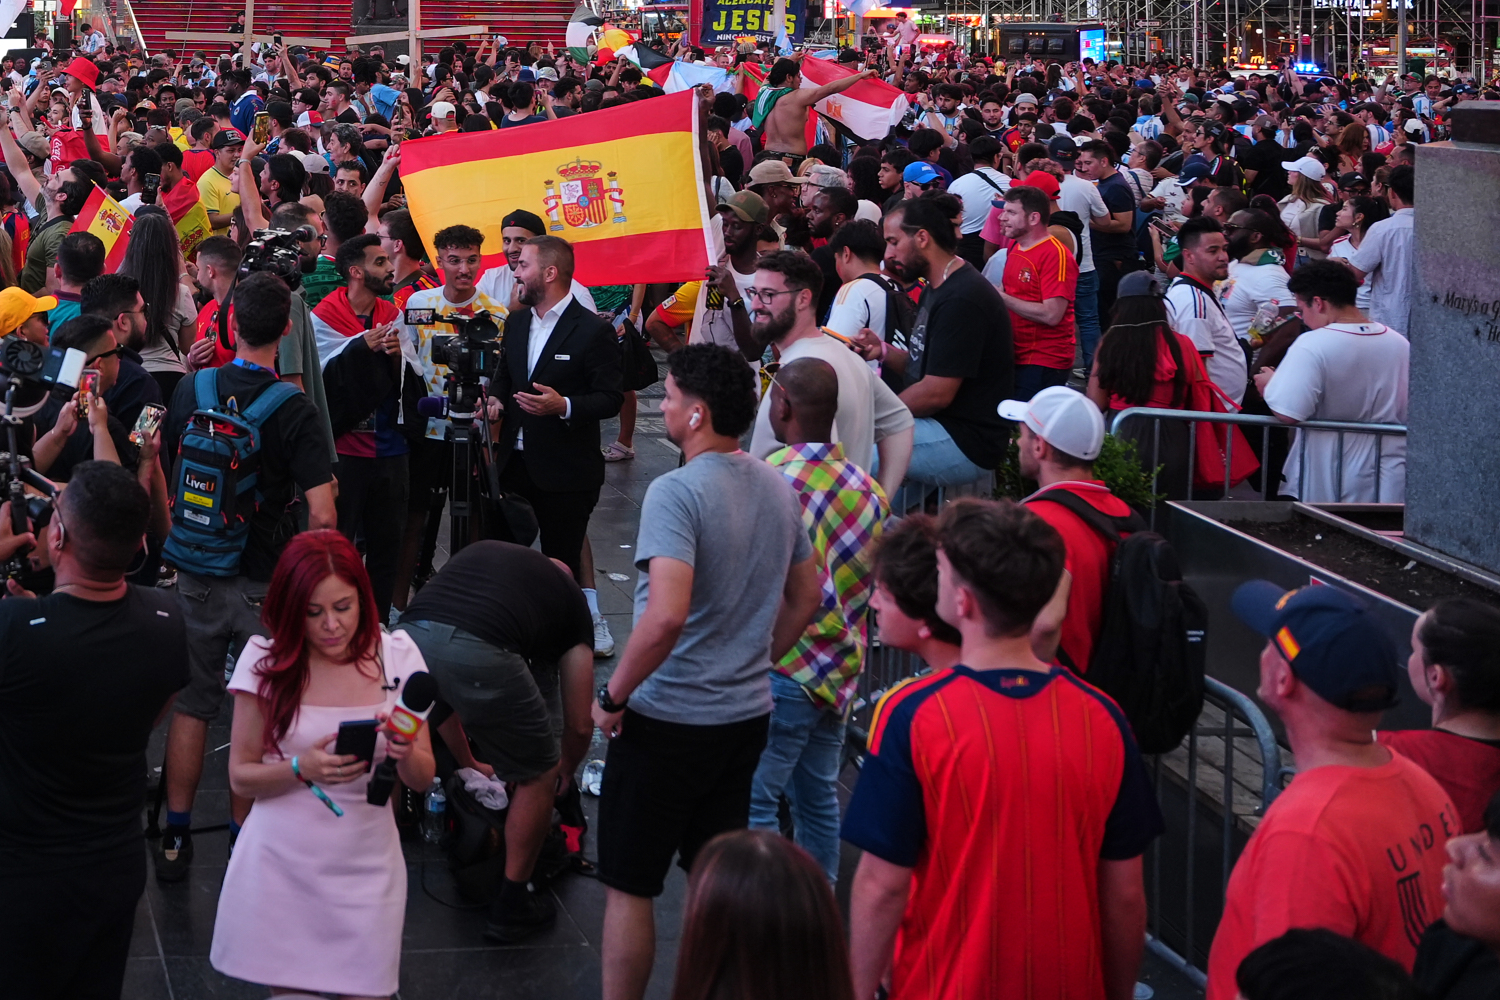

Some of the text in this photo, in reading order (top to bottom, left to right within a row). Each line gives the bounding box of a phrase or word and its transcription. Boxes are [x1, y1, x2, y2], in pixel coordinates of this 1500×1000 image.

[785, 0, 791, 8] A
[1480, 302, 1490, 315] a
[185, 474, 215, 492] LiveU
